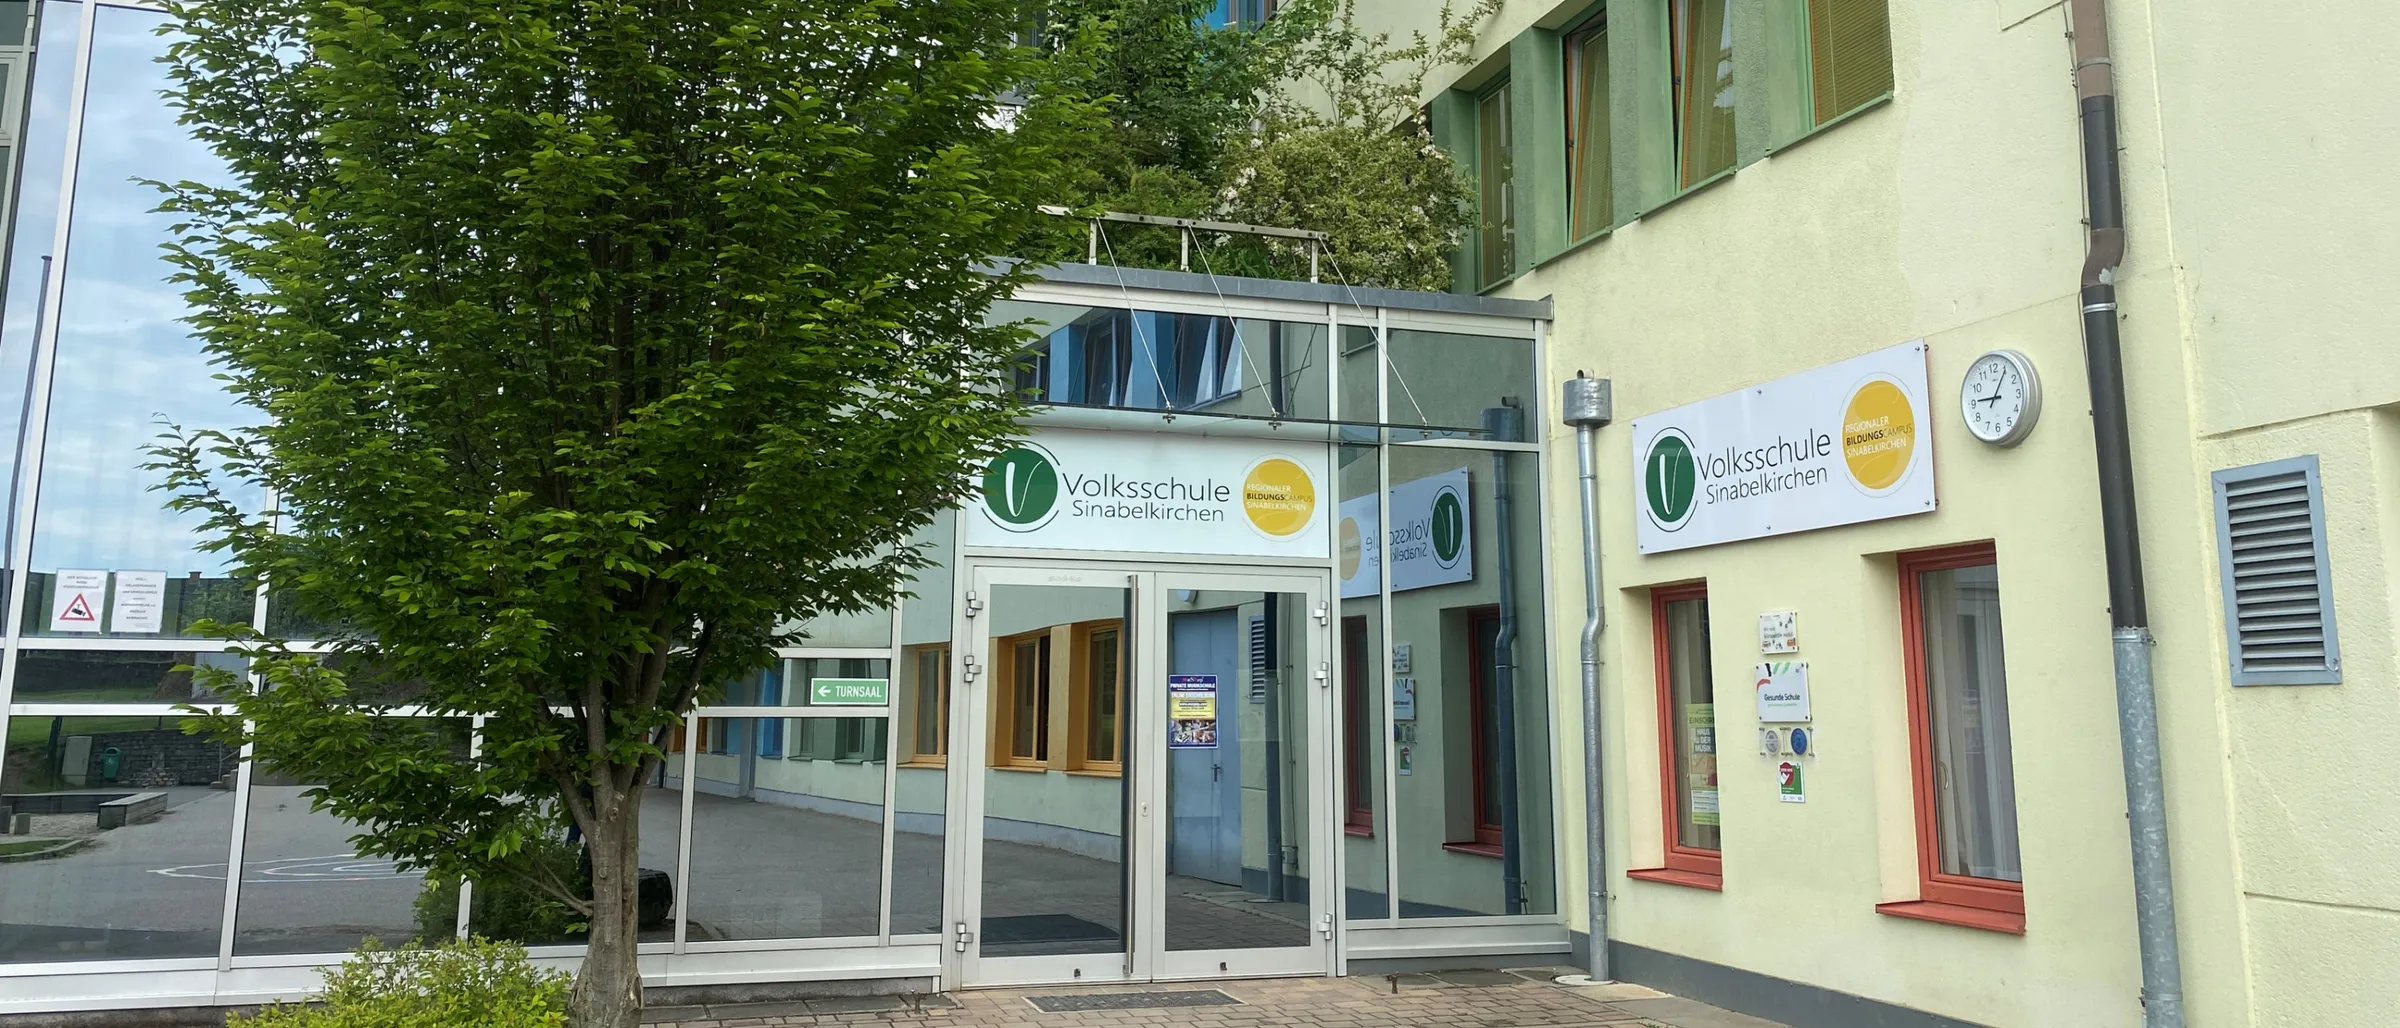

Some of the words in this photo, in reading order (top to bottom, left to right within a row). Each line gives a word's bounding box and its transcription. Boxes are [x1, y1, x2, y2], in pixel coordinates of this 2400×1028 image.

[1989, 363, 1999, 374] 12
[1979, 371, 1987, 380] 11
[2011, 374, 2017, 384] 2
[1973, 383, 1982, 393] 10
[2016, 389, 2021, 399] 3
[1971, 399, 1976, 409] 9
[2014, 404, 2019, 413] 4
[1975, 412, 1981, 422] 8
[2006, 417, 2012, 427] 5
[1845, 416, 1889, 433] REGIONALER
[1985, 421, 1991, 431] 7
[1995, 422, 2001, 432] 6
[1846, 423, 1913, 446] BILDUNGSCAMPUS
[1847, 437, 1907, 459] SINABELKIRCHEN
[1697, 428, 1831, 481] Volksschule
[1062, 473, 1230, 503] Volksschule
[1246, 484, 1291, 493] REGIONALER
[1706, 465, 1828, 505] Sinabelkirchen
[1246, 493, 1313, 503] BILDUNGSCAMPUS
[1073, 500, 1224, 522] Sinabelkirchen
[1246, 502, 1307, 511] SINABELKIRCHEN
[835, 685, 882, 698] TURNSAAL
[1764, 693, 1784, 701] Gesunde
[1784, 693, 1801, 701] Schule
[1696, 727, 1711, 736] HAUS
[1700, 736, 1711, 744] DER
[1694, 743, 1712, 753] MUSIK
